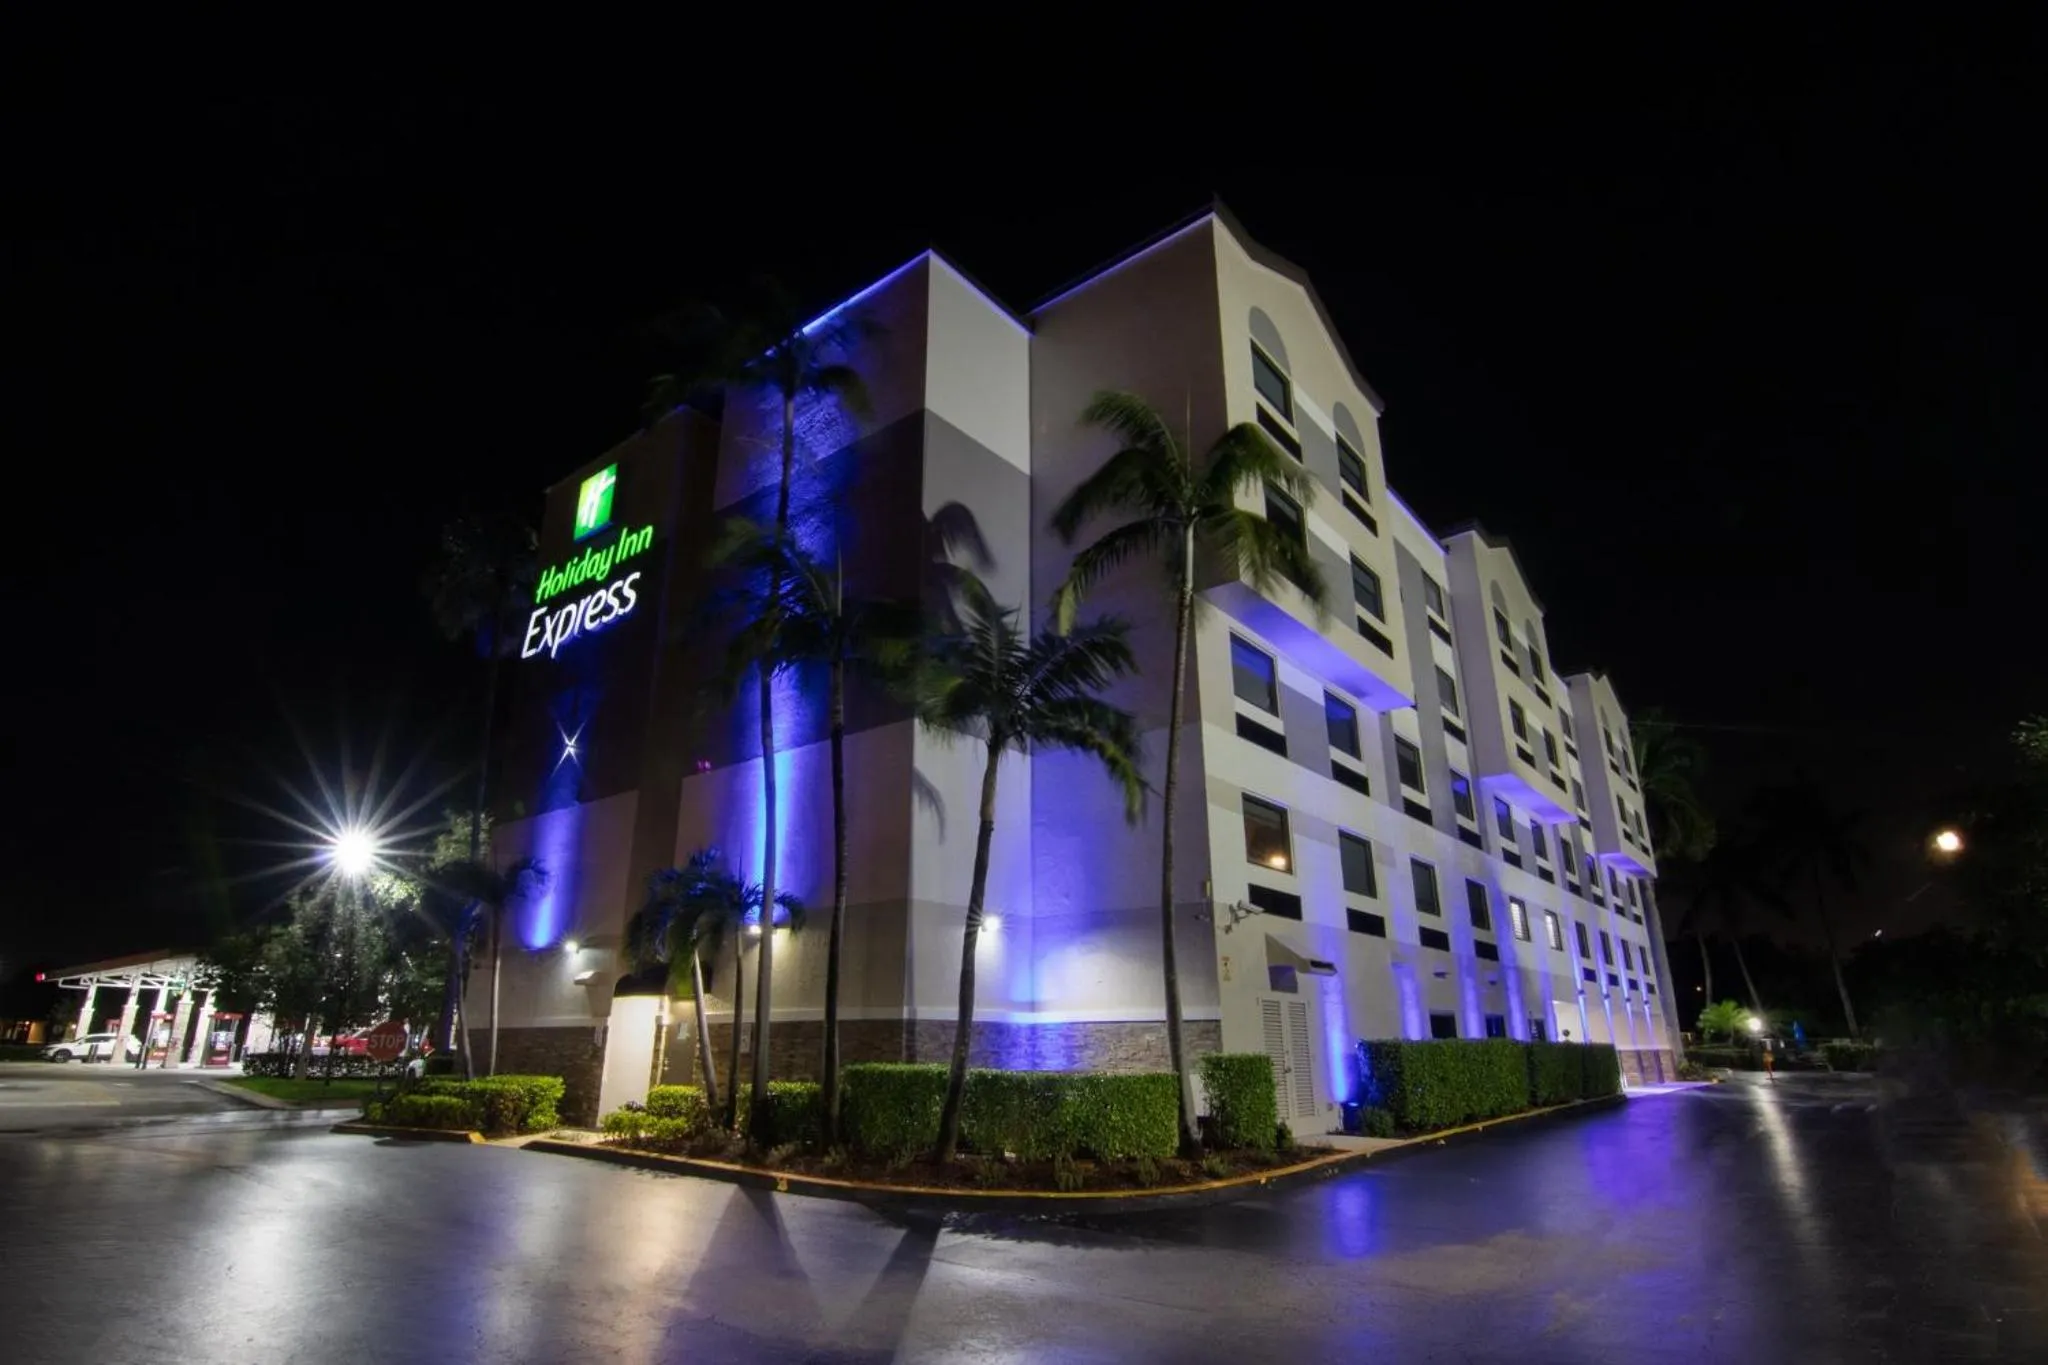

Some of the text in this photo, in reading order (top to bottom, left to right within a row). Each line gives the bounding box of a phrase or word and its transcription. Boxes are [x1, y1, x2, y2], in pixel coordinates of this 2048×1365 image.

[536, 525, 653, 603] Holiday Inn
[521, 571, 641, 659] Express
[370, 1034, 404, 1049] STOP
